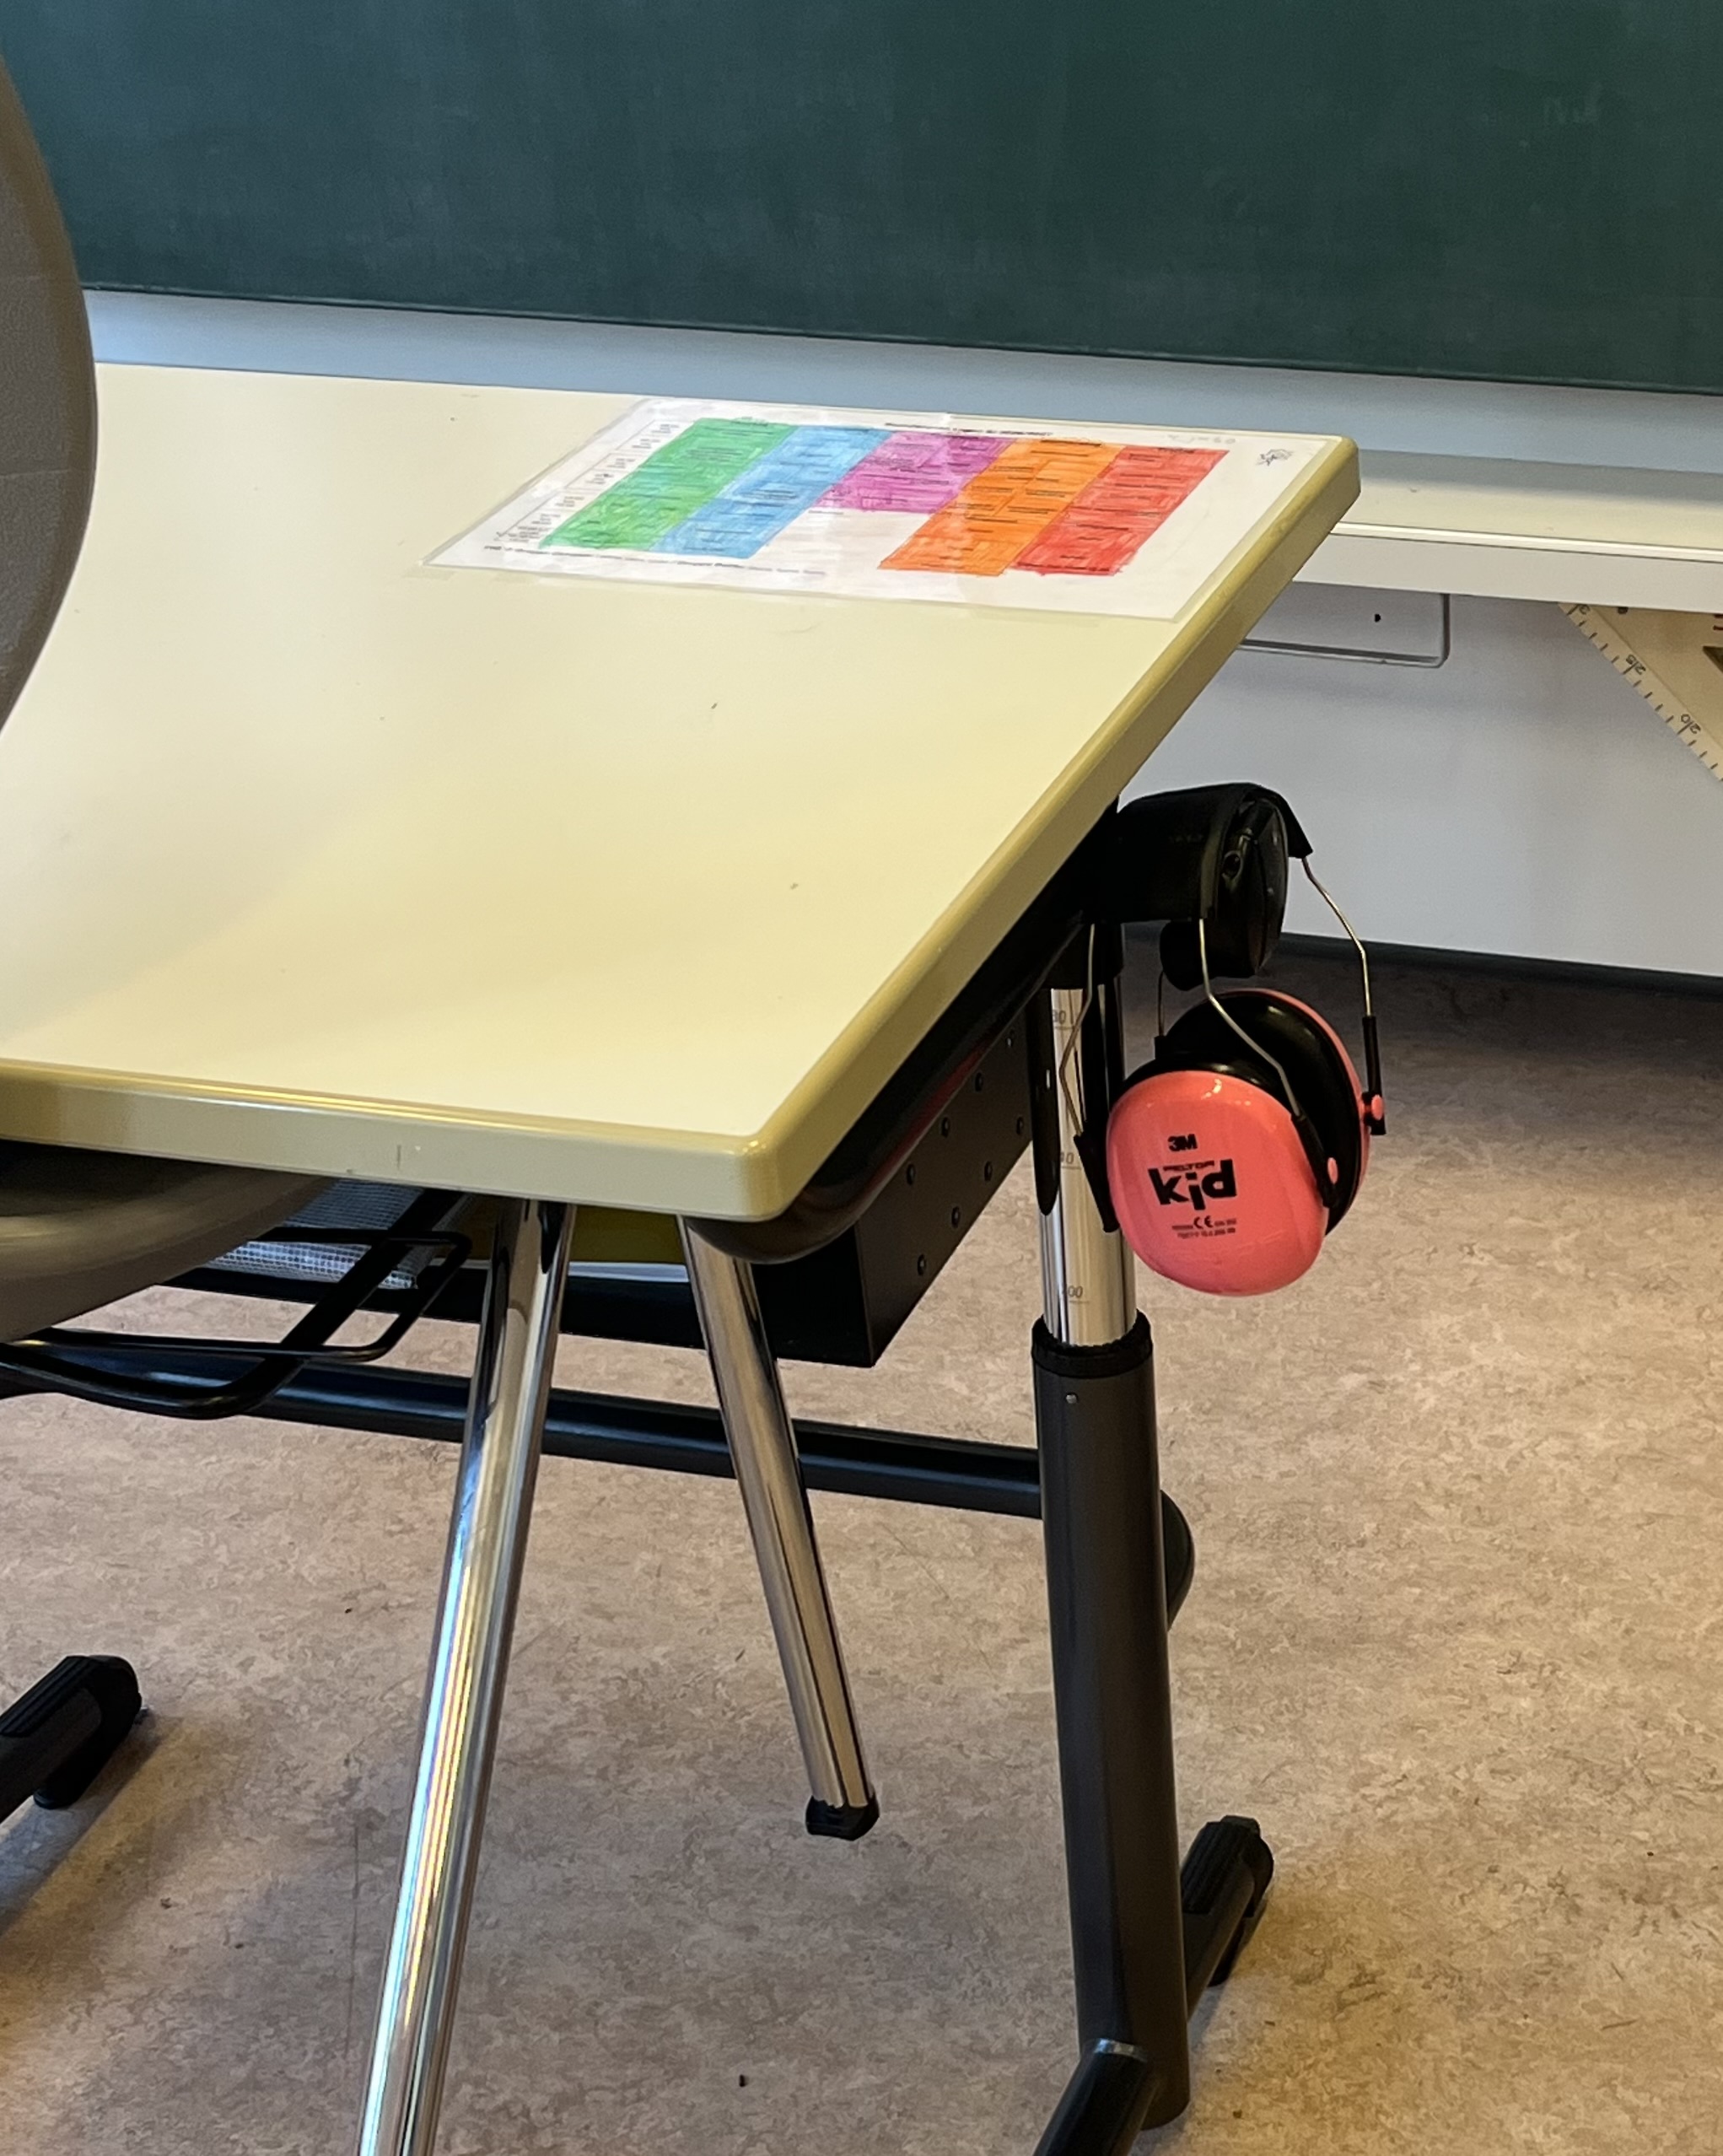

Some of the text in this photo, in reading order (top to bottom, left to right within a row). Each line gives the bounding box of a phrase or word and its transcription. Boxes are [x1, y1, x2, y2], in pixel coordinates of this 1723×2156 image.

[1680, 714, 1701, 735] 20
[1168, 1134, 1198, 1151] 3M
[1147, 1159, 1237, 1210] kid
